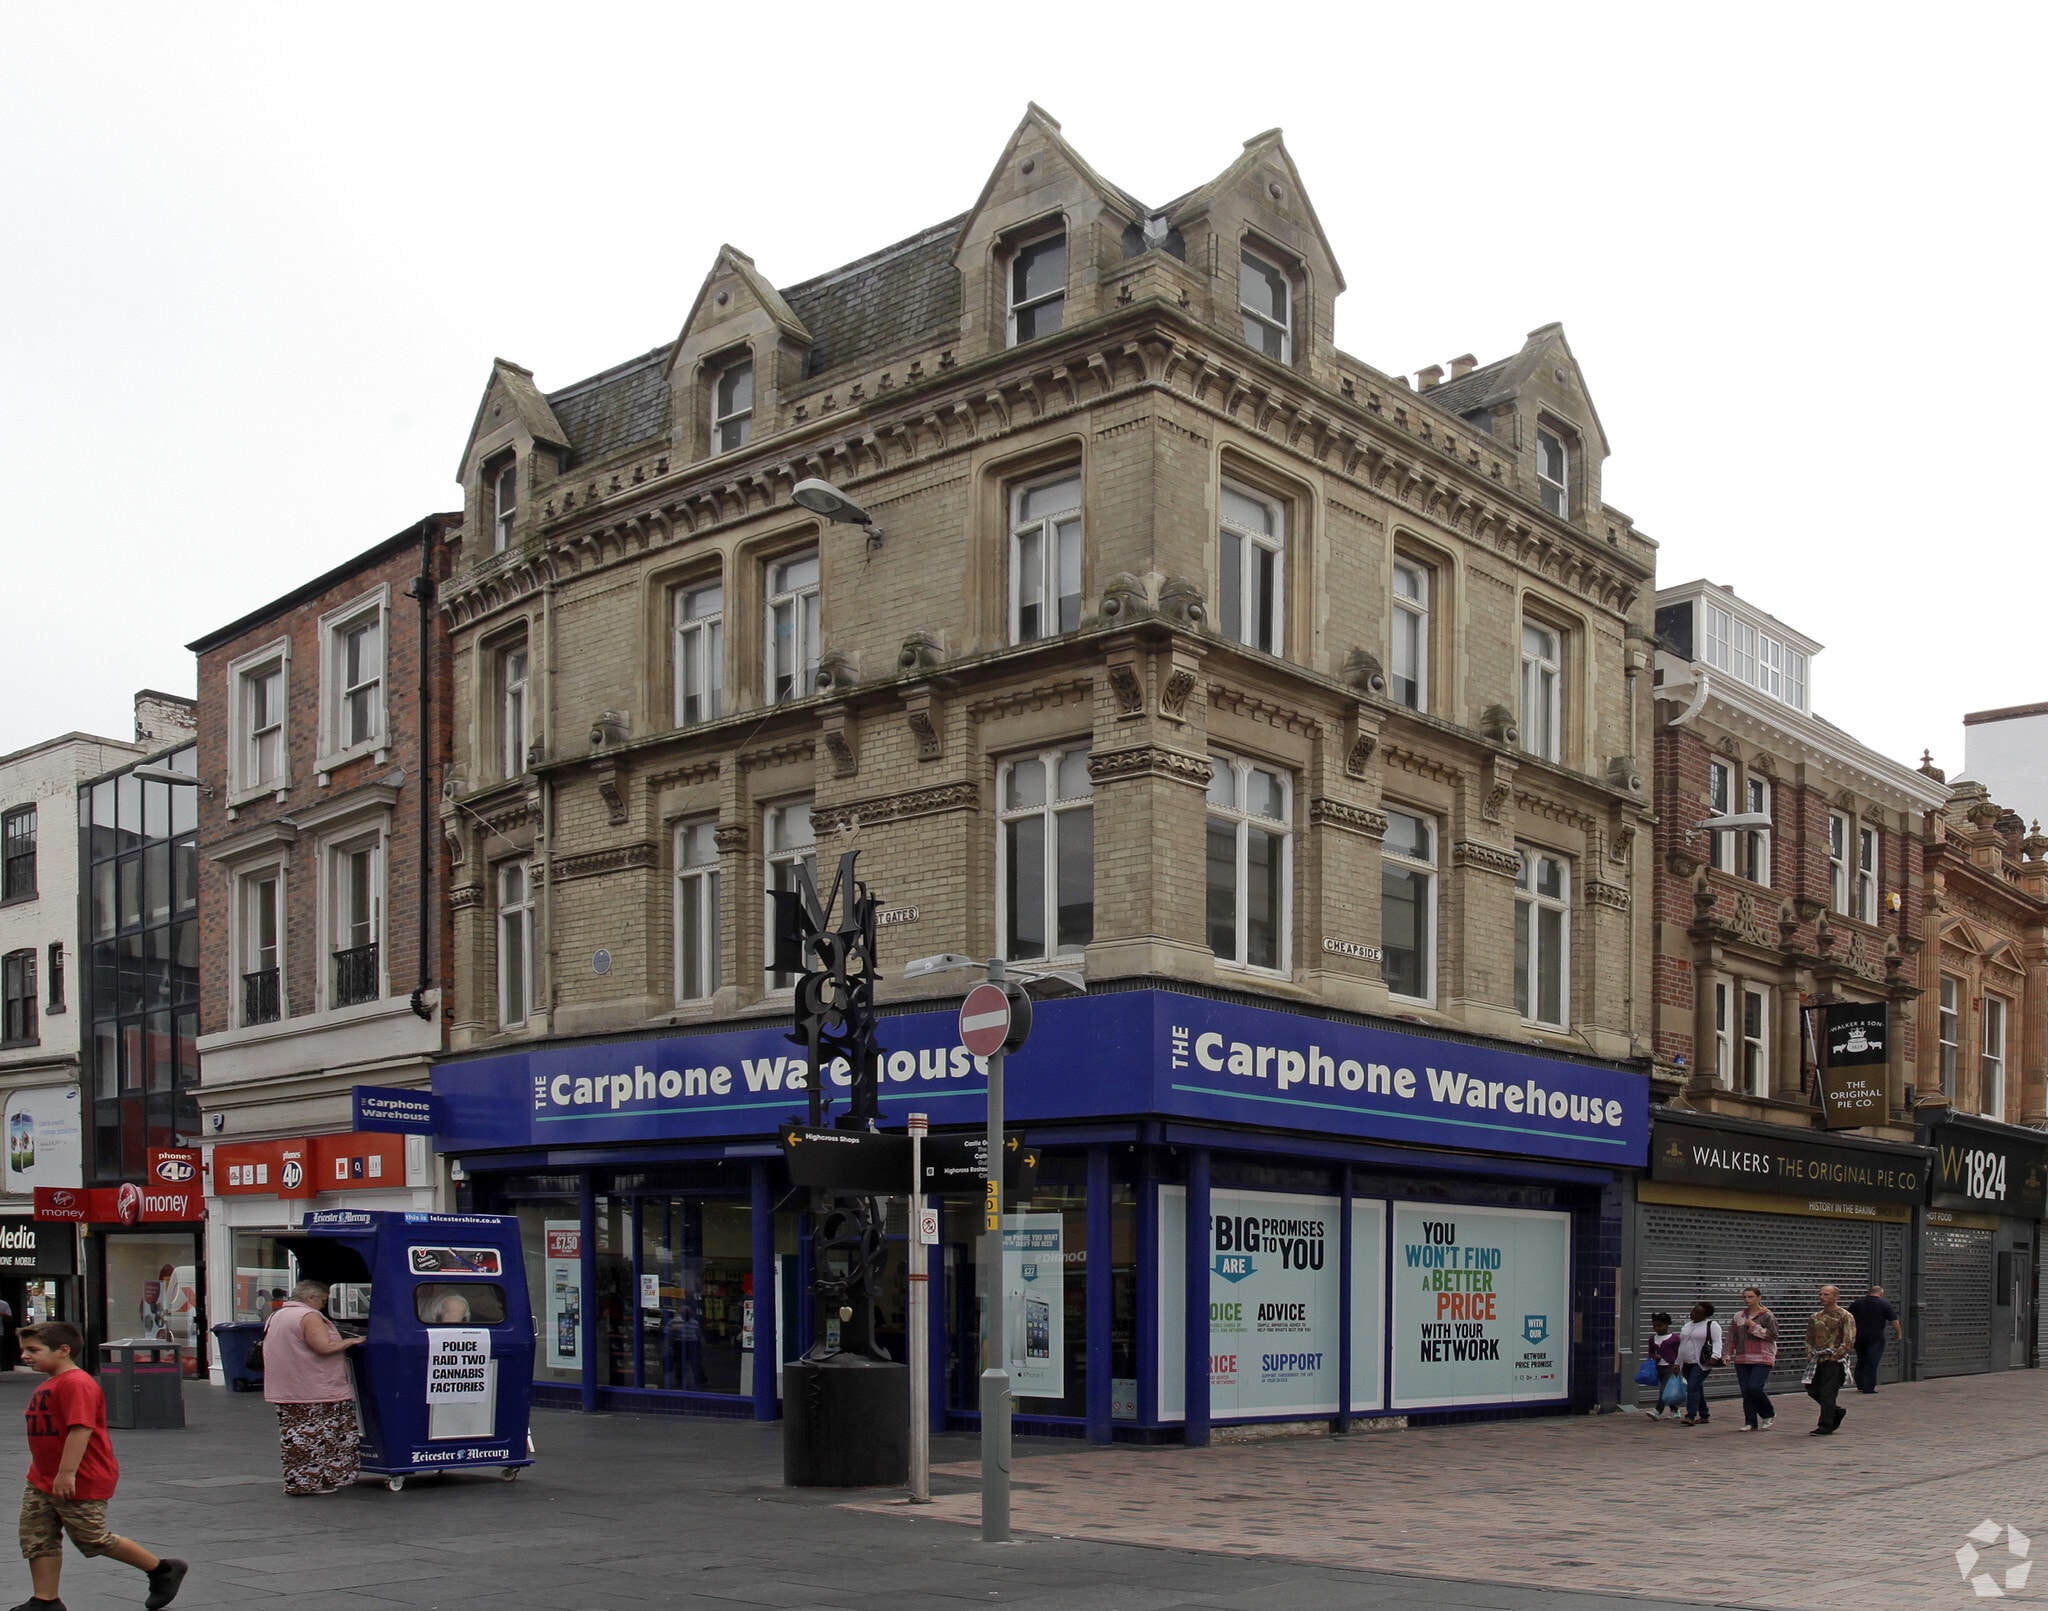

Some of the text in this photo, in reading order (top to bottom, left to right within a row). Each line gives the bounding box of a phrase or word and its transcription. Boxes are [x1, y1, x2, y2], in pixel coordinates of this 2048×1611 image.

[886, 908, 914, 922] GATES
[1327, 940, 1379, 959] CHEAPSIDE
[1830, 1021, 1858, 1032] WALKER
[535, 1045, 988, 1110] THE Carphone Waeouse
[1172, 1025, 1623, 1127] THE Carphone Warehouse
[1846, 1080, 1866, 1088] THE
[1830, 1089, 1882, 1100] ORIGINAL
[367, 1098, 430, 1110] Carphone
[1837, 1100, 1852, 1108] PIE
[361, 1109, 430, 1121] Warehouse
[806, 1132, 860, 1144] Highcross Shops
[158, 1152, 192, 1160] phones
[161, 1162, 192, 1180] 4u
[282, 1163, 299, 1187] 4u
[1692, 1146, 1919, 1190] WALKERS THE ORIGINAL PIE CO.
[146, 1195, 188, 1217] money
[1809, 1202, 1834, 1212] HISTORY
[1835, 1203, 1842, 1212] IN
[1842, 1204, 1854, 1214] THE
[1855, 1205, 1876, 1216] BAKING
[41, 1208, 85, 1220] money
[313, 1212, 370, 1224] Leicester Mercury
[430, 1215, 501, 1224] leicestershire.co.uk
[1926, 1212, 1952, 1222] HOT FOOD
[1215, 1215, 1260, 1252] BIG
[1262, 1218, 1324, 1238] PROMISES
[1423, 1222, 1456, 1245] YOU
[1262, 1237, 1324, 1270] TO YOU
[1405, 1245, 1502, 1270] WON'T FIND
[0, 1256, 36, 1266] ONE MOBILE
[1222, 1258, 1246, 1274] ARE
[1422, 1270, 1493, 1292] A BETTER
[1210, 1303, 1242, 1321] OICE
[1258, 1304, 1305, 1321] ADVICE
[1437, 1292, 1497, 1320] PRICE
[1528, 1319, 1543, 1328] WITH
[1421, 1324, 1483, 1338] WITH YOUR
[1530, 1329, 1542, 1338] OUR
[442, 1341, 478, 1352] POLICE
[1420, 1339, 1500, 1362] NETWORK
[432, 1354, 486, 1366] RAID TWO
[1208, 1355, 1237, 1373] RICE
[1262, 1353, 1323, 1371] SUPPORT
[1515, 1361, 1530, 1369] PRICE
[432, 1368, 485, 1379] CANNABIS
[430, 1381, 485, 1393] FACTORIES
[412, 1448, 510, 1463] Leicester Mercury
